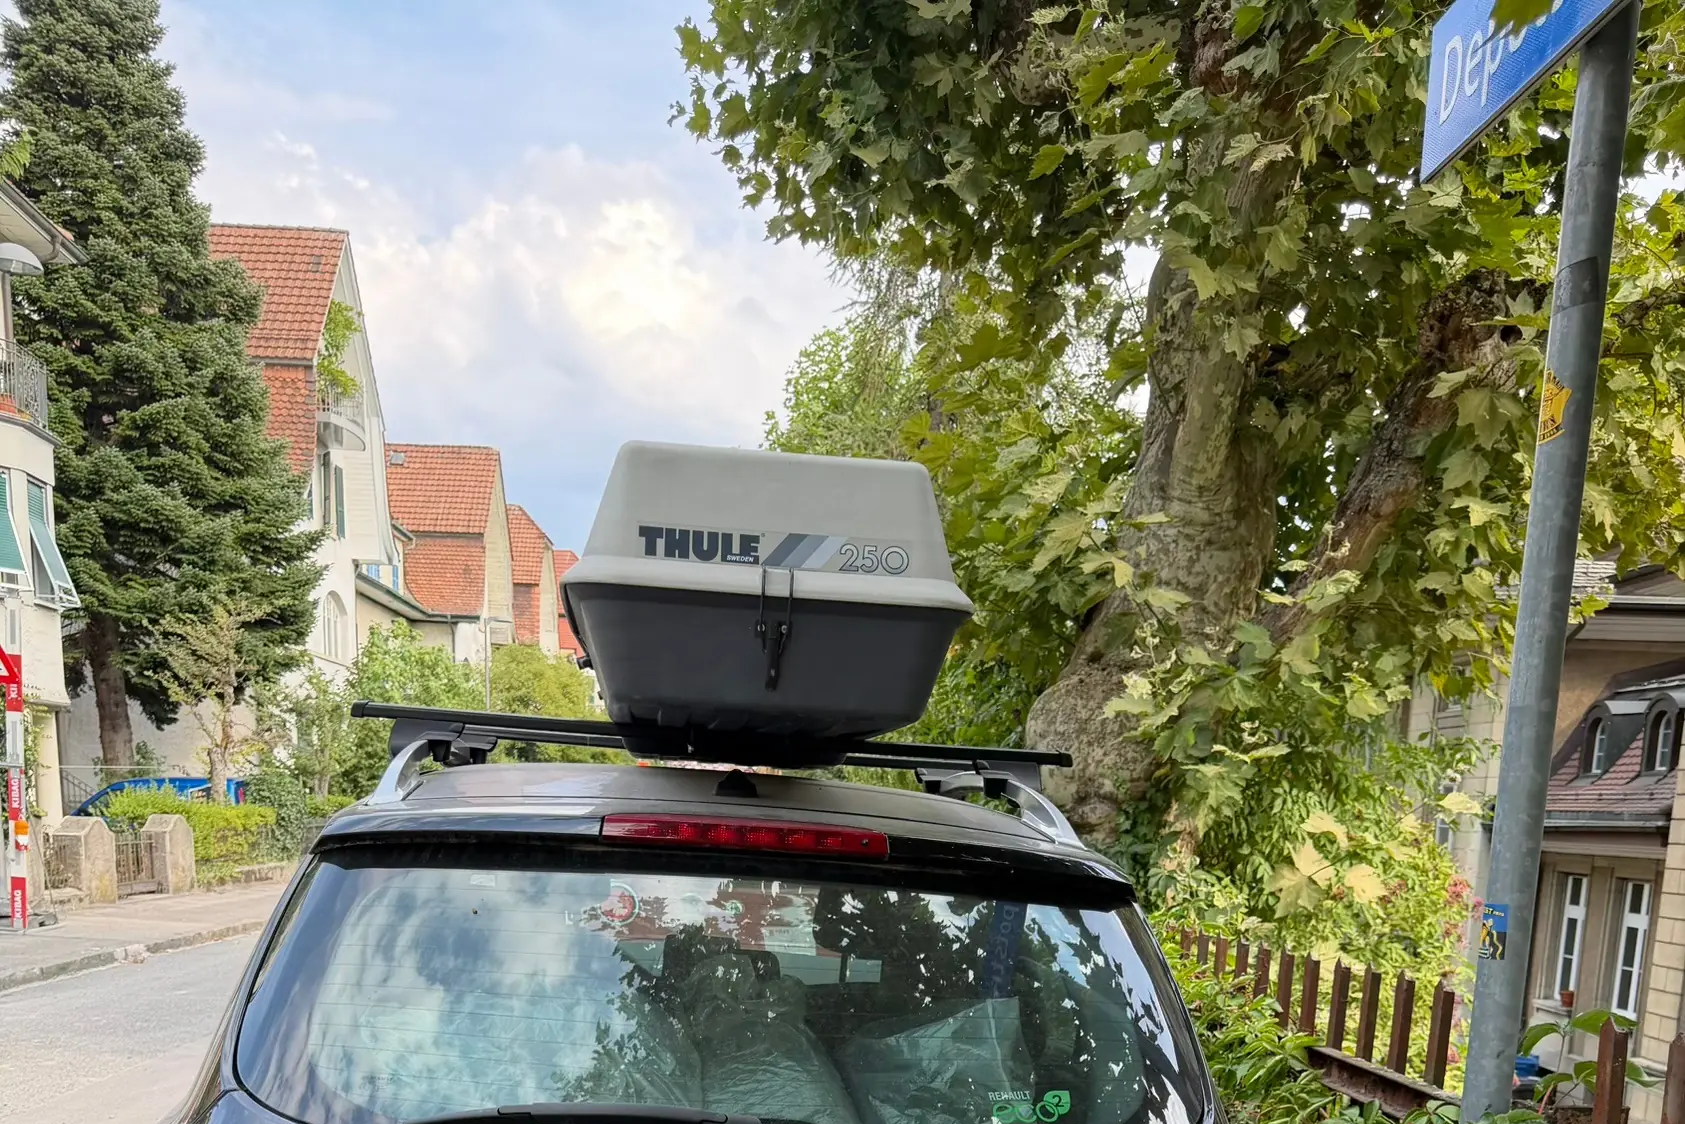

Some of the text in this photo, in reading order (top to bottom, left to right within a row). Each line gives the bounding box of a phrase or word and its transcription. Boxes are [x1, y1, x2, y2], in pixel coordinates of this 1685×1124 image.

[638, 525, 760, 565] THULE
[726, 554, 755, 563] SWEDEN
[838, 543, 910, 575] 250
[11, 778, 20, 809] KIBAG
[13, 889, 22, 919] KIBAG
[987, 1090, 1031, 1102] RENAULT
